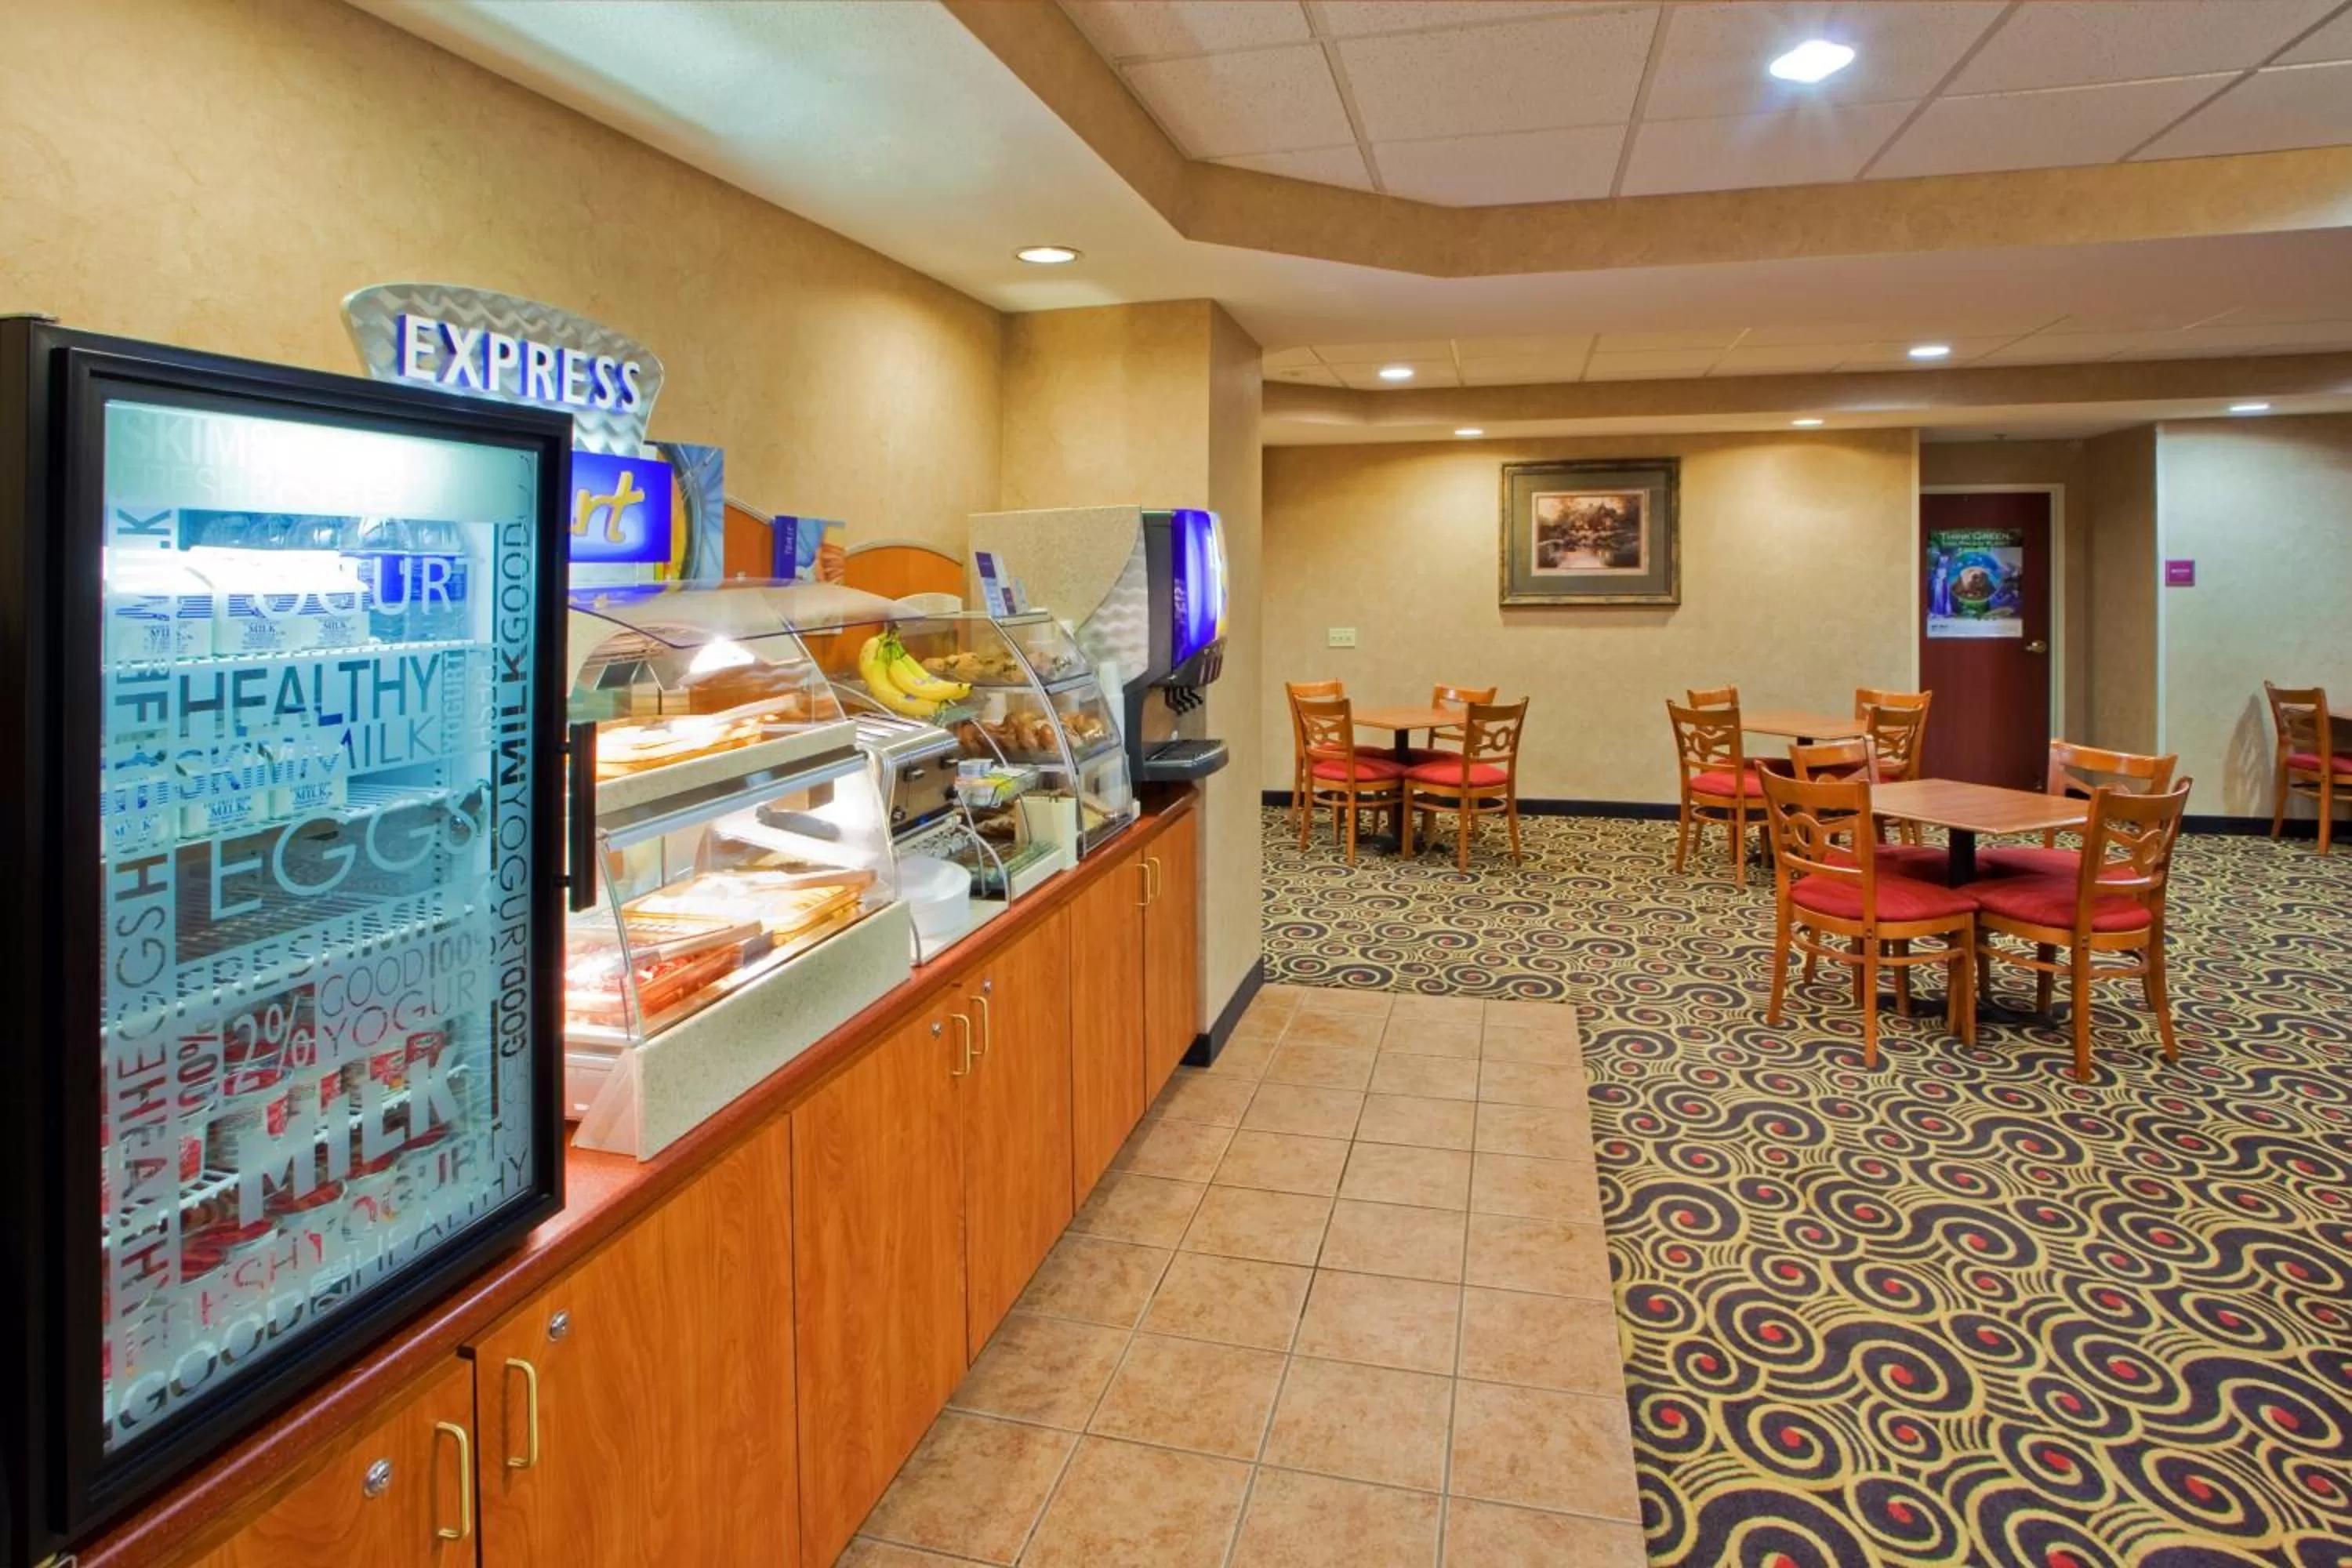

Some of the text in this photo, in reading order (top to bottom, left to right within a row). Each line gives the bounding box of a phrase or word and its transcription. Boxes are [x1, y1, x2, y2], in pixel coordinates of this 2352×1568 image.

[397, 313, 641, 412] EXPRESS
[501, 519, 531, 644] GOOD
[178, 651, 441, 741] HEALTHY
[499, 644, 529, 787] MILK
[210, 780, 485, 922] EGGS
[499, 786, 530, 967] YOGURT
[500, 966, 528, 1059] GOOD
[235, 1043, 461, 1231] MILK
[118, 1290, 305, 1430] GOOD
